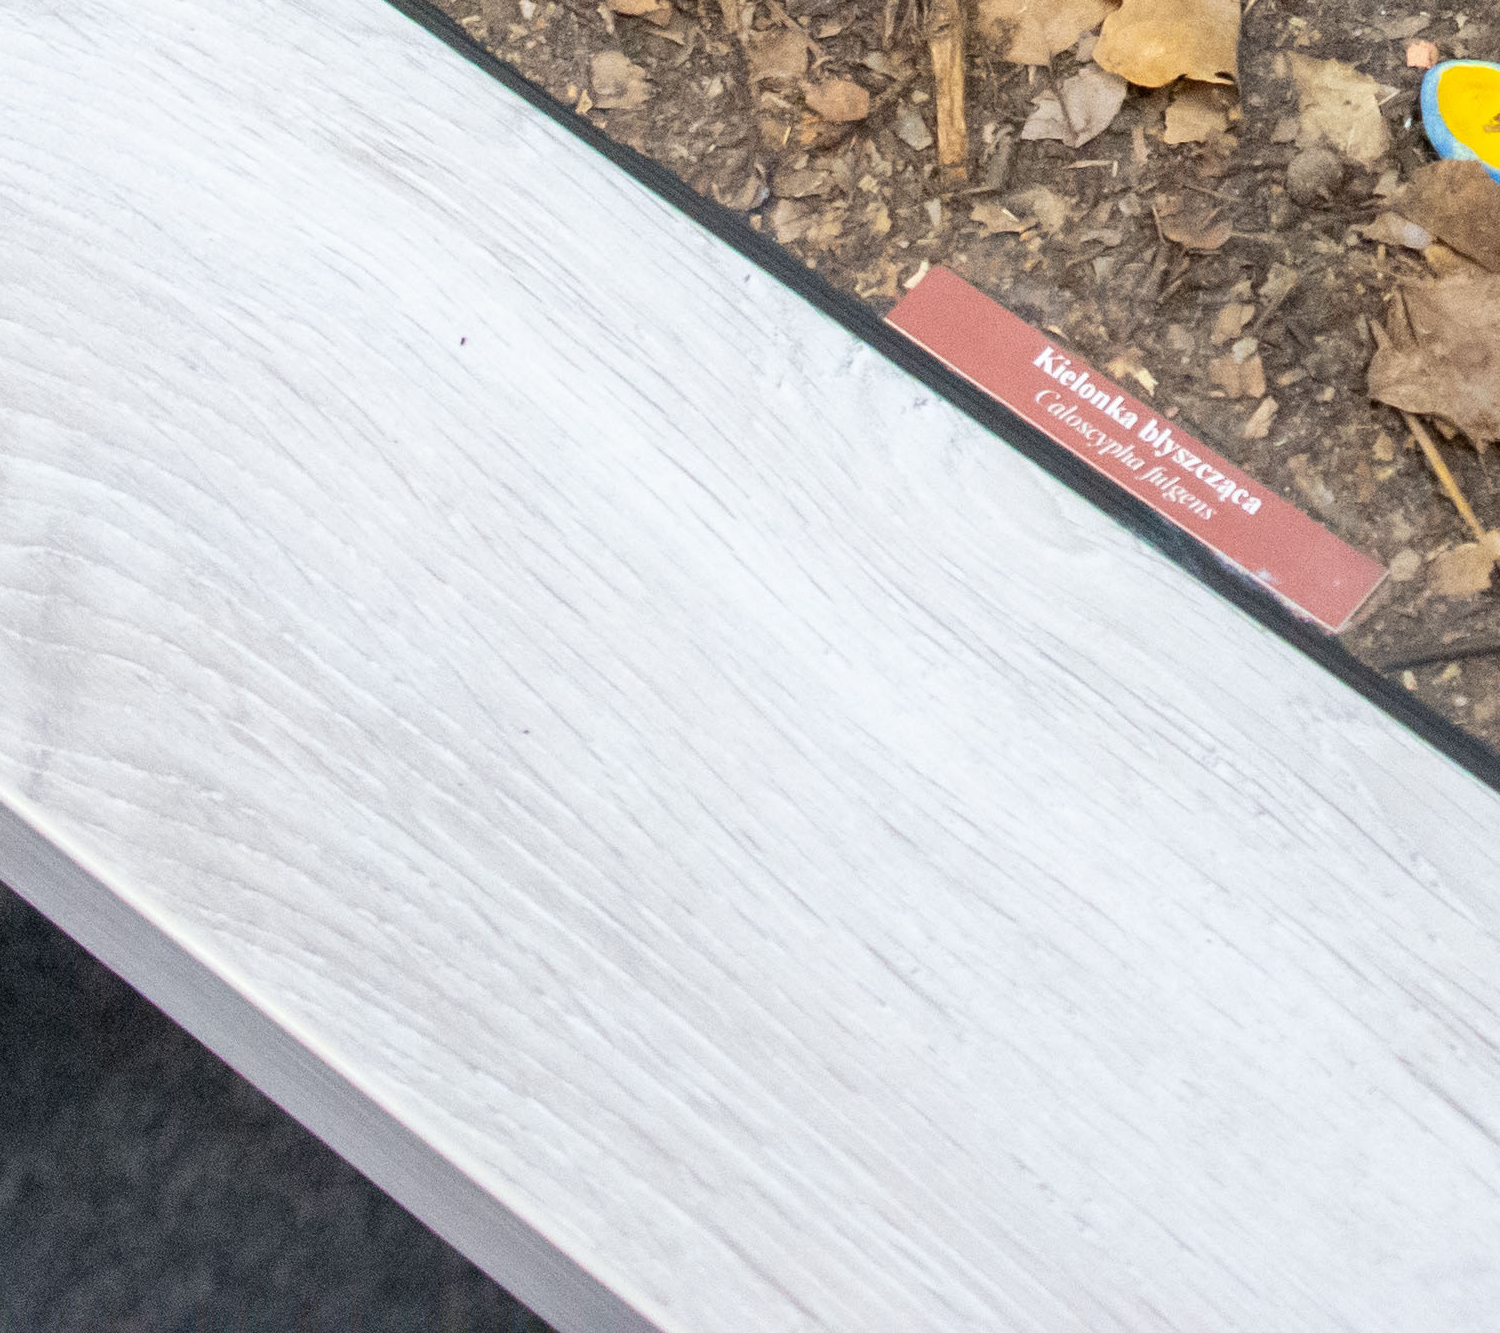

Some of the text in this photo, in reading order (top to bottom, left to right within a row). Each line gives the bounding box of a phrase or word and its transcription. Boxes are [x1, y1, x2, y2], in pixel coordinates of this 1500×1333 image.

[1033, 346, 1262, 515] Kielonka błyszcząca
[1035, 390, 1217, 520] Caloscypha fulgens
